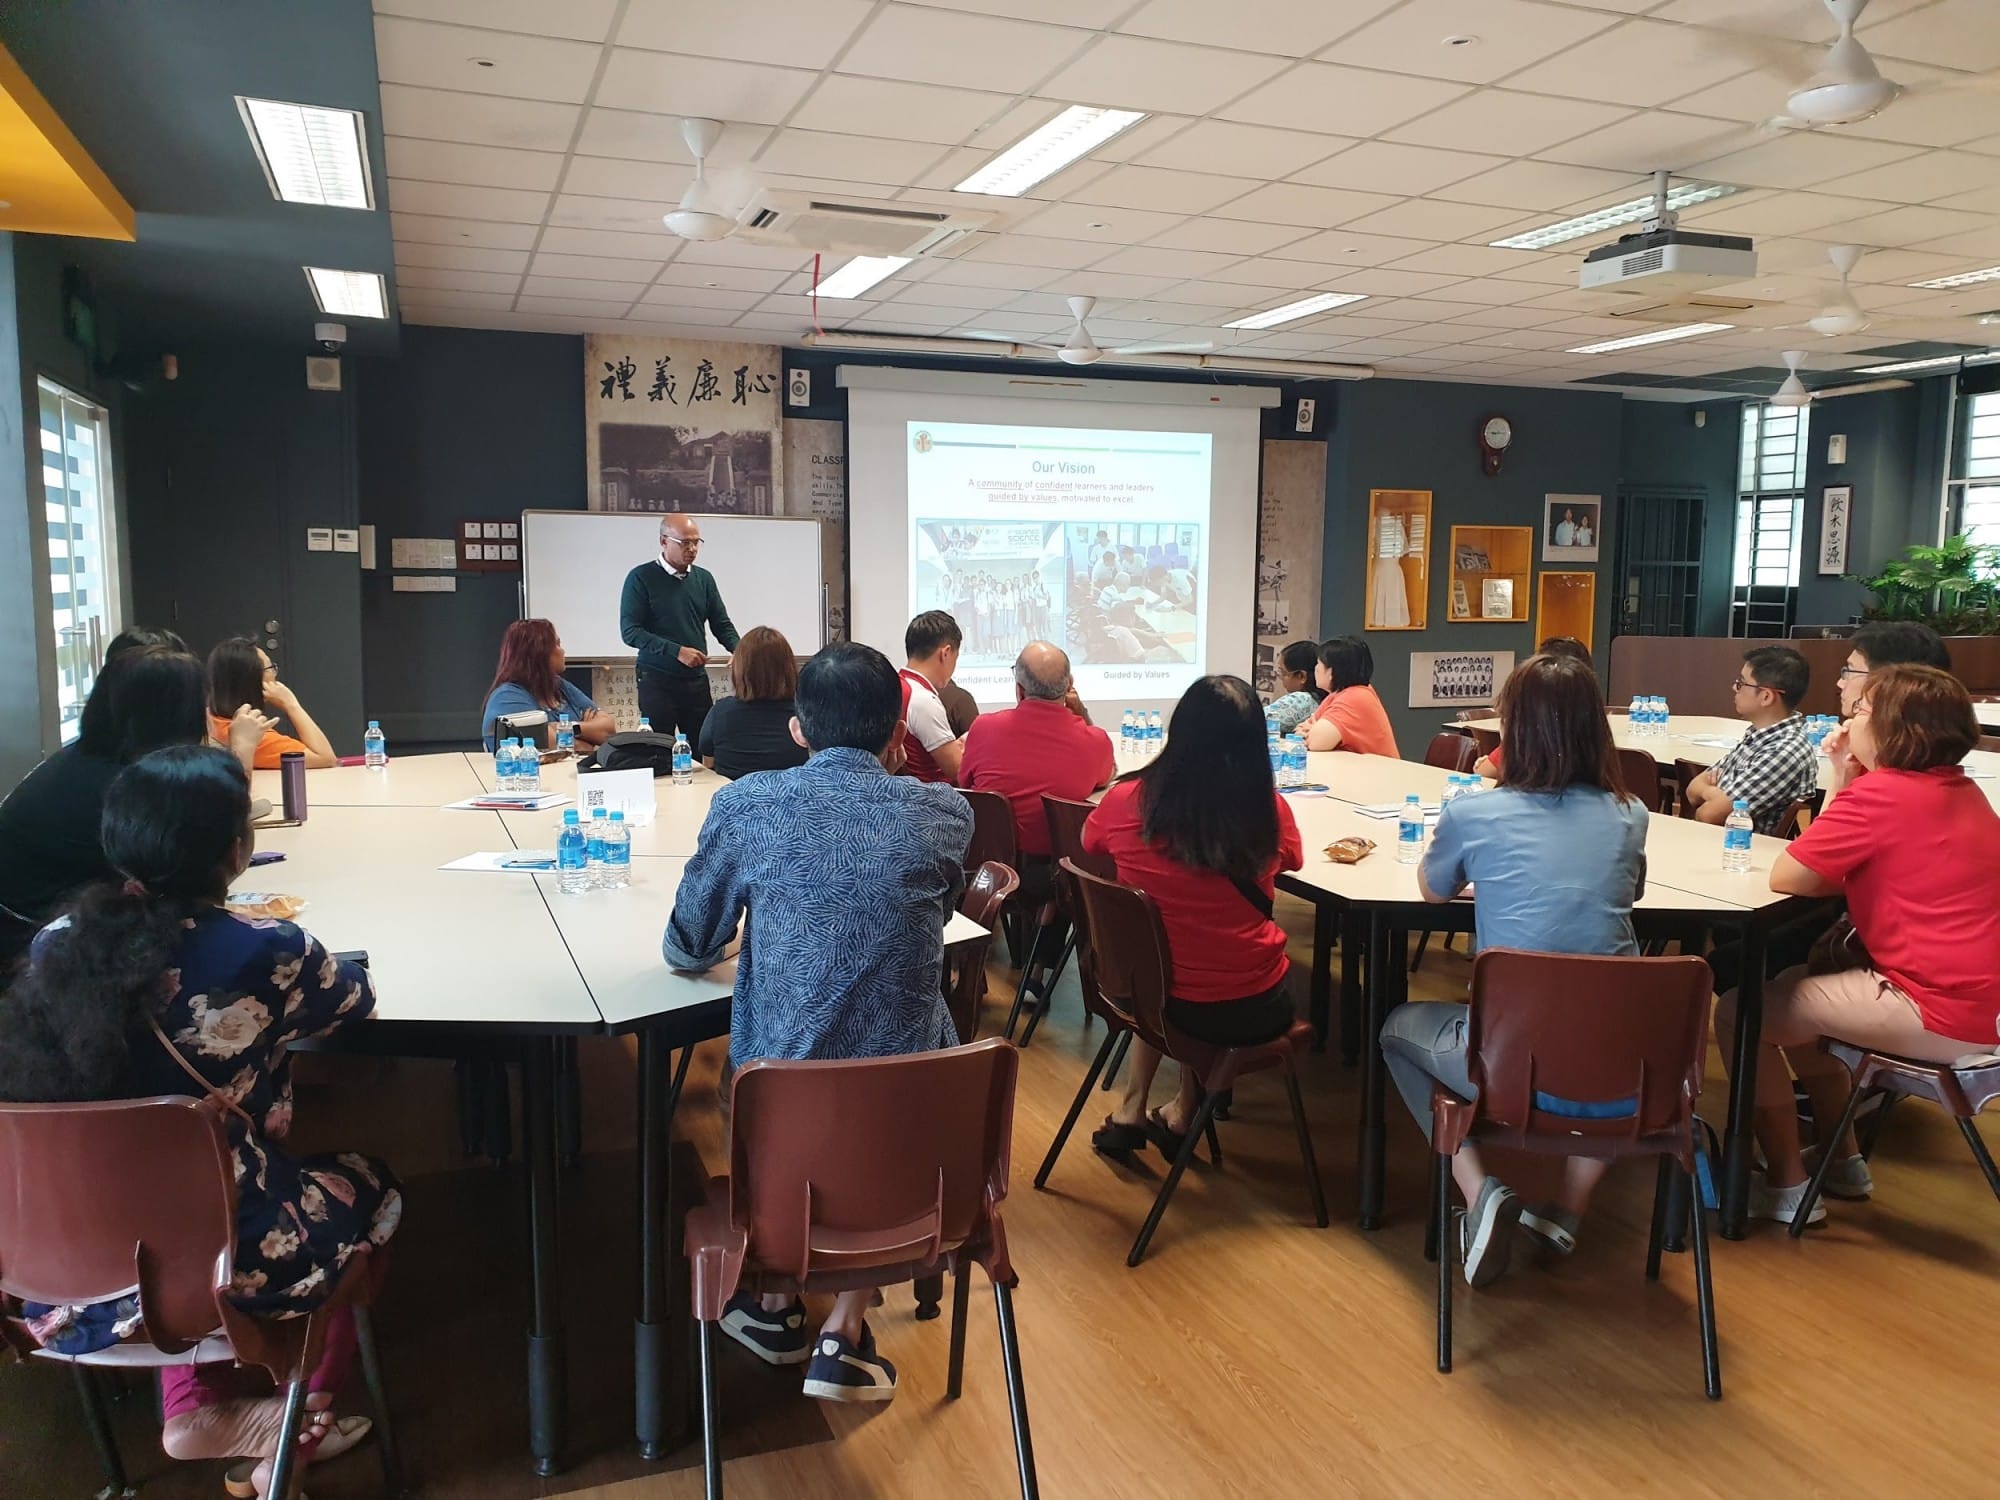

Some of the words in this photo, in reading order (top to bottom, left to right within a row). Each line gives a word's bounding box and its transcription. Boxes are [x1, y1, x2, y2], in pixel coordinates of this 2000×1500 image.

[1032, 460, 1054, 474] Our
[1058, 461, 1096, 475] Vision
[968, 478, 975, 487] A
[976, 479, 1023, 489] community
[1024, 480, 1033, 488] of
[1035, 480, 1073, 489] confident
[1074, 481, 1110, 491] learners
[1110, 482, 1125, 491] and
[1126, 483, 1154, 492] leaders
[988, 492, 1017, 502] guided
[1019, 493, 1028, 502] by
[1061, 494, 1101, 503] motivated
[1103, 495, 1111, 503] to
[1103, 671, 1131, 680] Guided
[1133, 671, 1142, 681] by
[1144, 671, 1170, 680] Values
